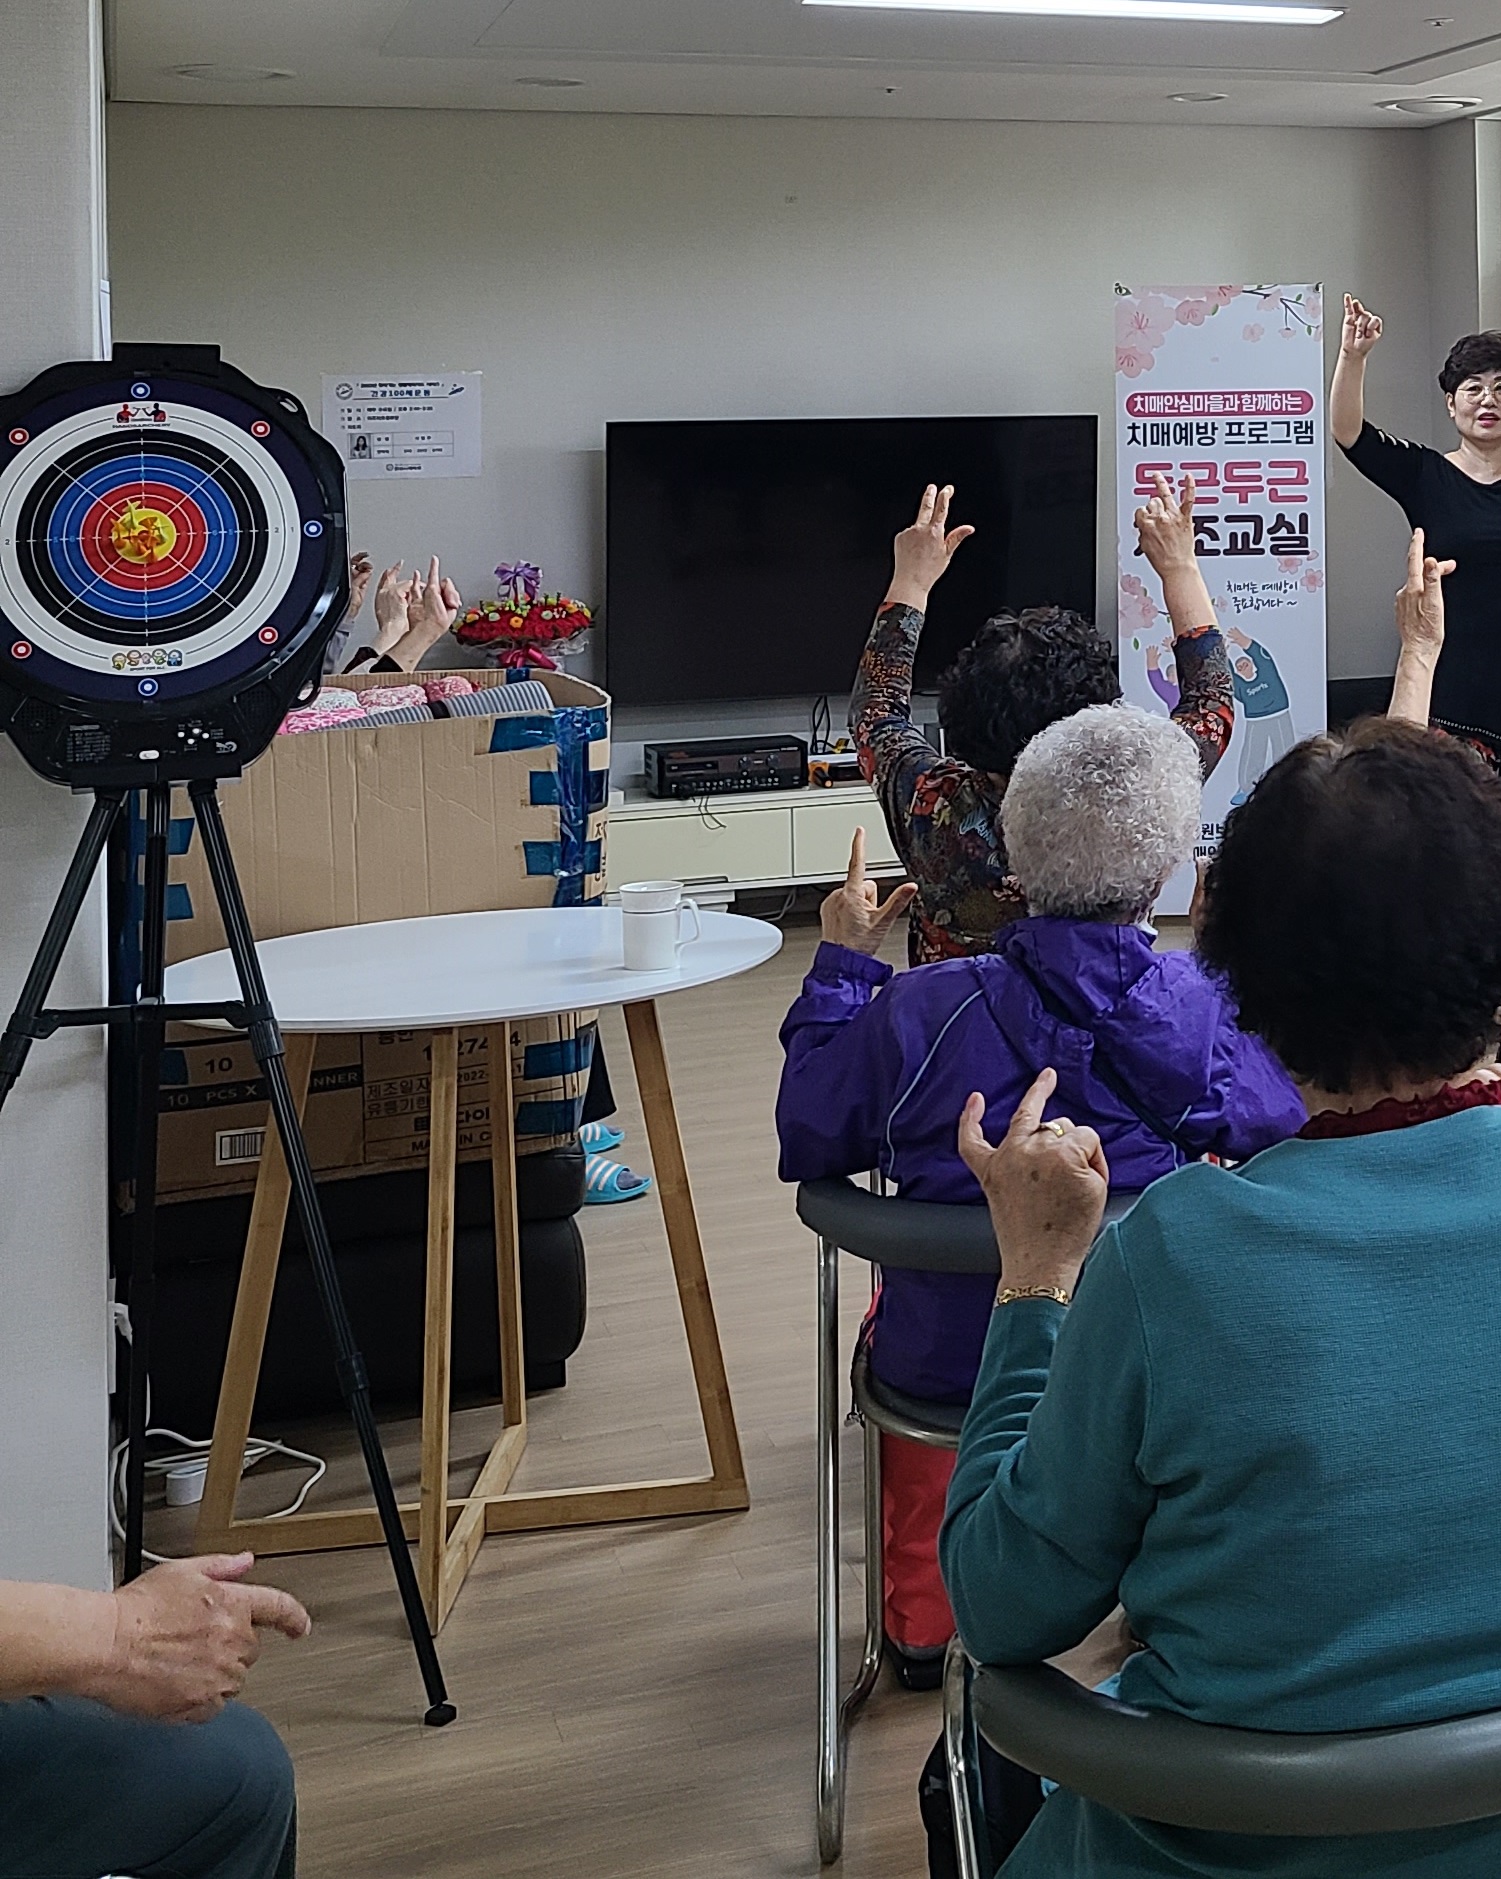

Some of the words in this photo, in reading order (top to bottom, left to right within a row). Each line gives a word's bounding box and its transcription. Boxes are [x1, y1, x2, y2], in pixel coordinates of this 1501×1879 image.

[1133, 394, 1240, 414] 치매안심마을과
[1241, 393, 1303, 413] 함께하는
[1126, 421, 1219, 447] 치매예방
[1223, 420, 1315, 445] 프로그램
[1133, 460, 1310, 505] 두근두근
[274, 526, 280, 534] 2
[1133, 512, 1311, 557] 조교실
[1226, 580, 1259, 594] 치매는
[1261, 579, 1298, 594] 예방이
[204, 1057, 233, 1074] 10
[167, 1094, 189, 1107] 10
[206, 1088, 238, 1102] PCS
[244, 1084, 258, 1096] X
[312, 1072, 359, 1088] NNER
[367, 1077, 430, 1098] 제조일자
[459, 1133, 473, 1145] IN
